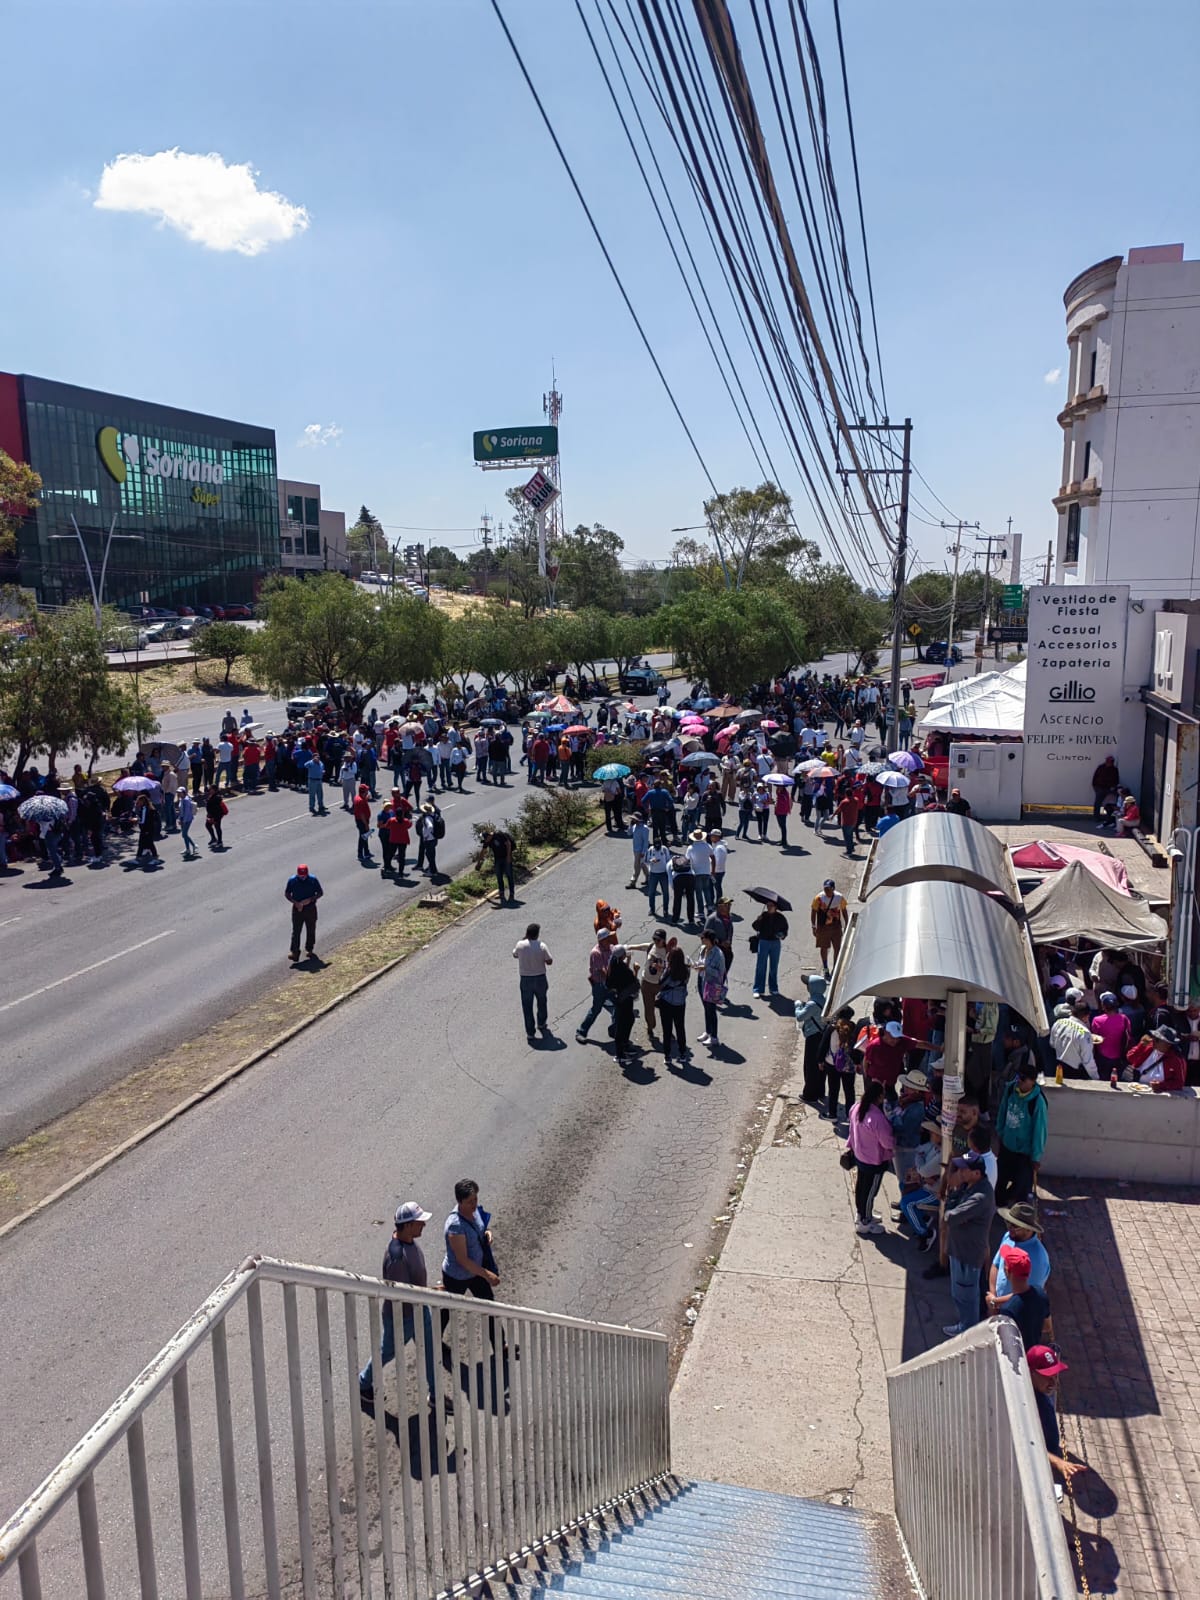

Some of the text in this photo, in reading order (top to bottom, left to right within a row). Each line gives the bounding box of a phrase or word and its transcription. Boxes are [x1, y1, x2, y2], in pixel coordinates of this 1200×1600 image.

[501, 434, 543, 448] Soriana
[145, 447, 223, 485] Soriana
[524, 474, 546, 499] CITY
[532, 482, 553, 508] CLUB
[1042, 593, 1117, 605] Vestido de
[1057, 606, 1099, 616] Fiesta
[1052, 625, 1101, 635] Casual
[1038, 640, 1118, 650] Accesorios
[1027, 735, 1118, 745] FELIPE RIVERA
